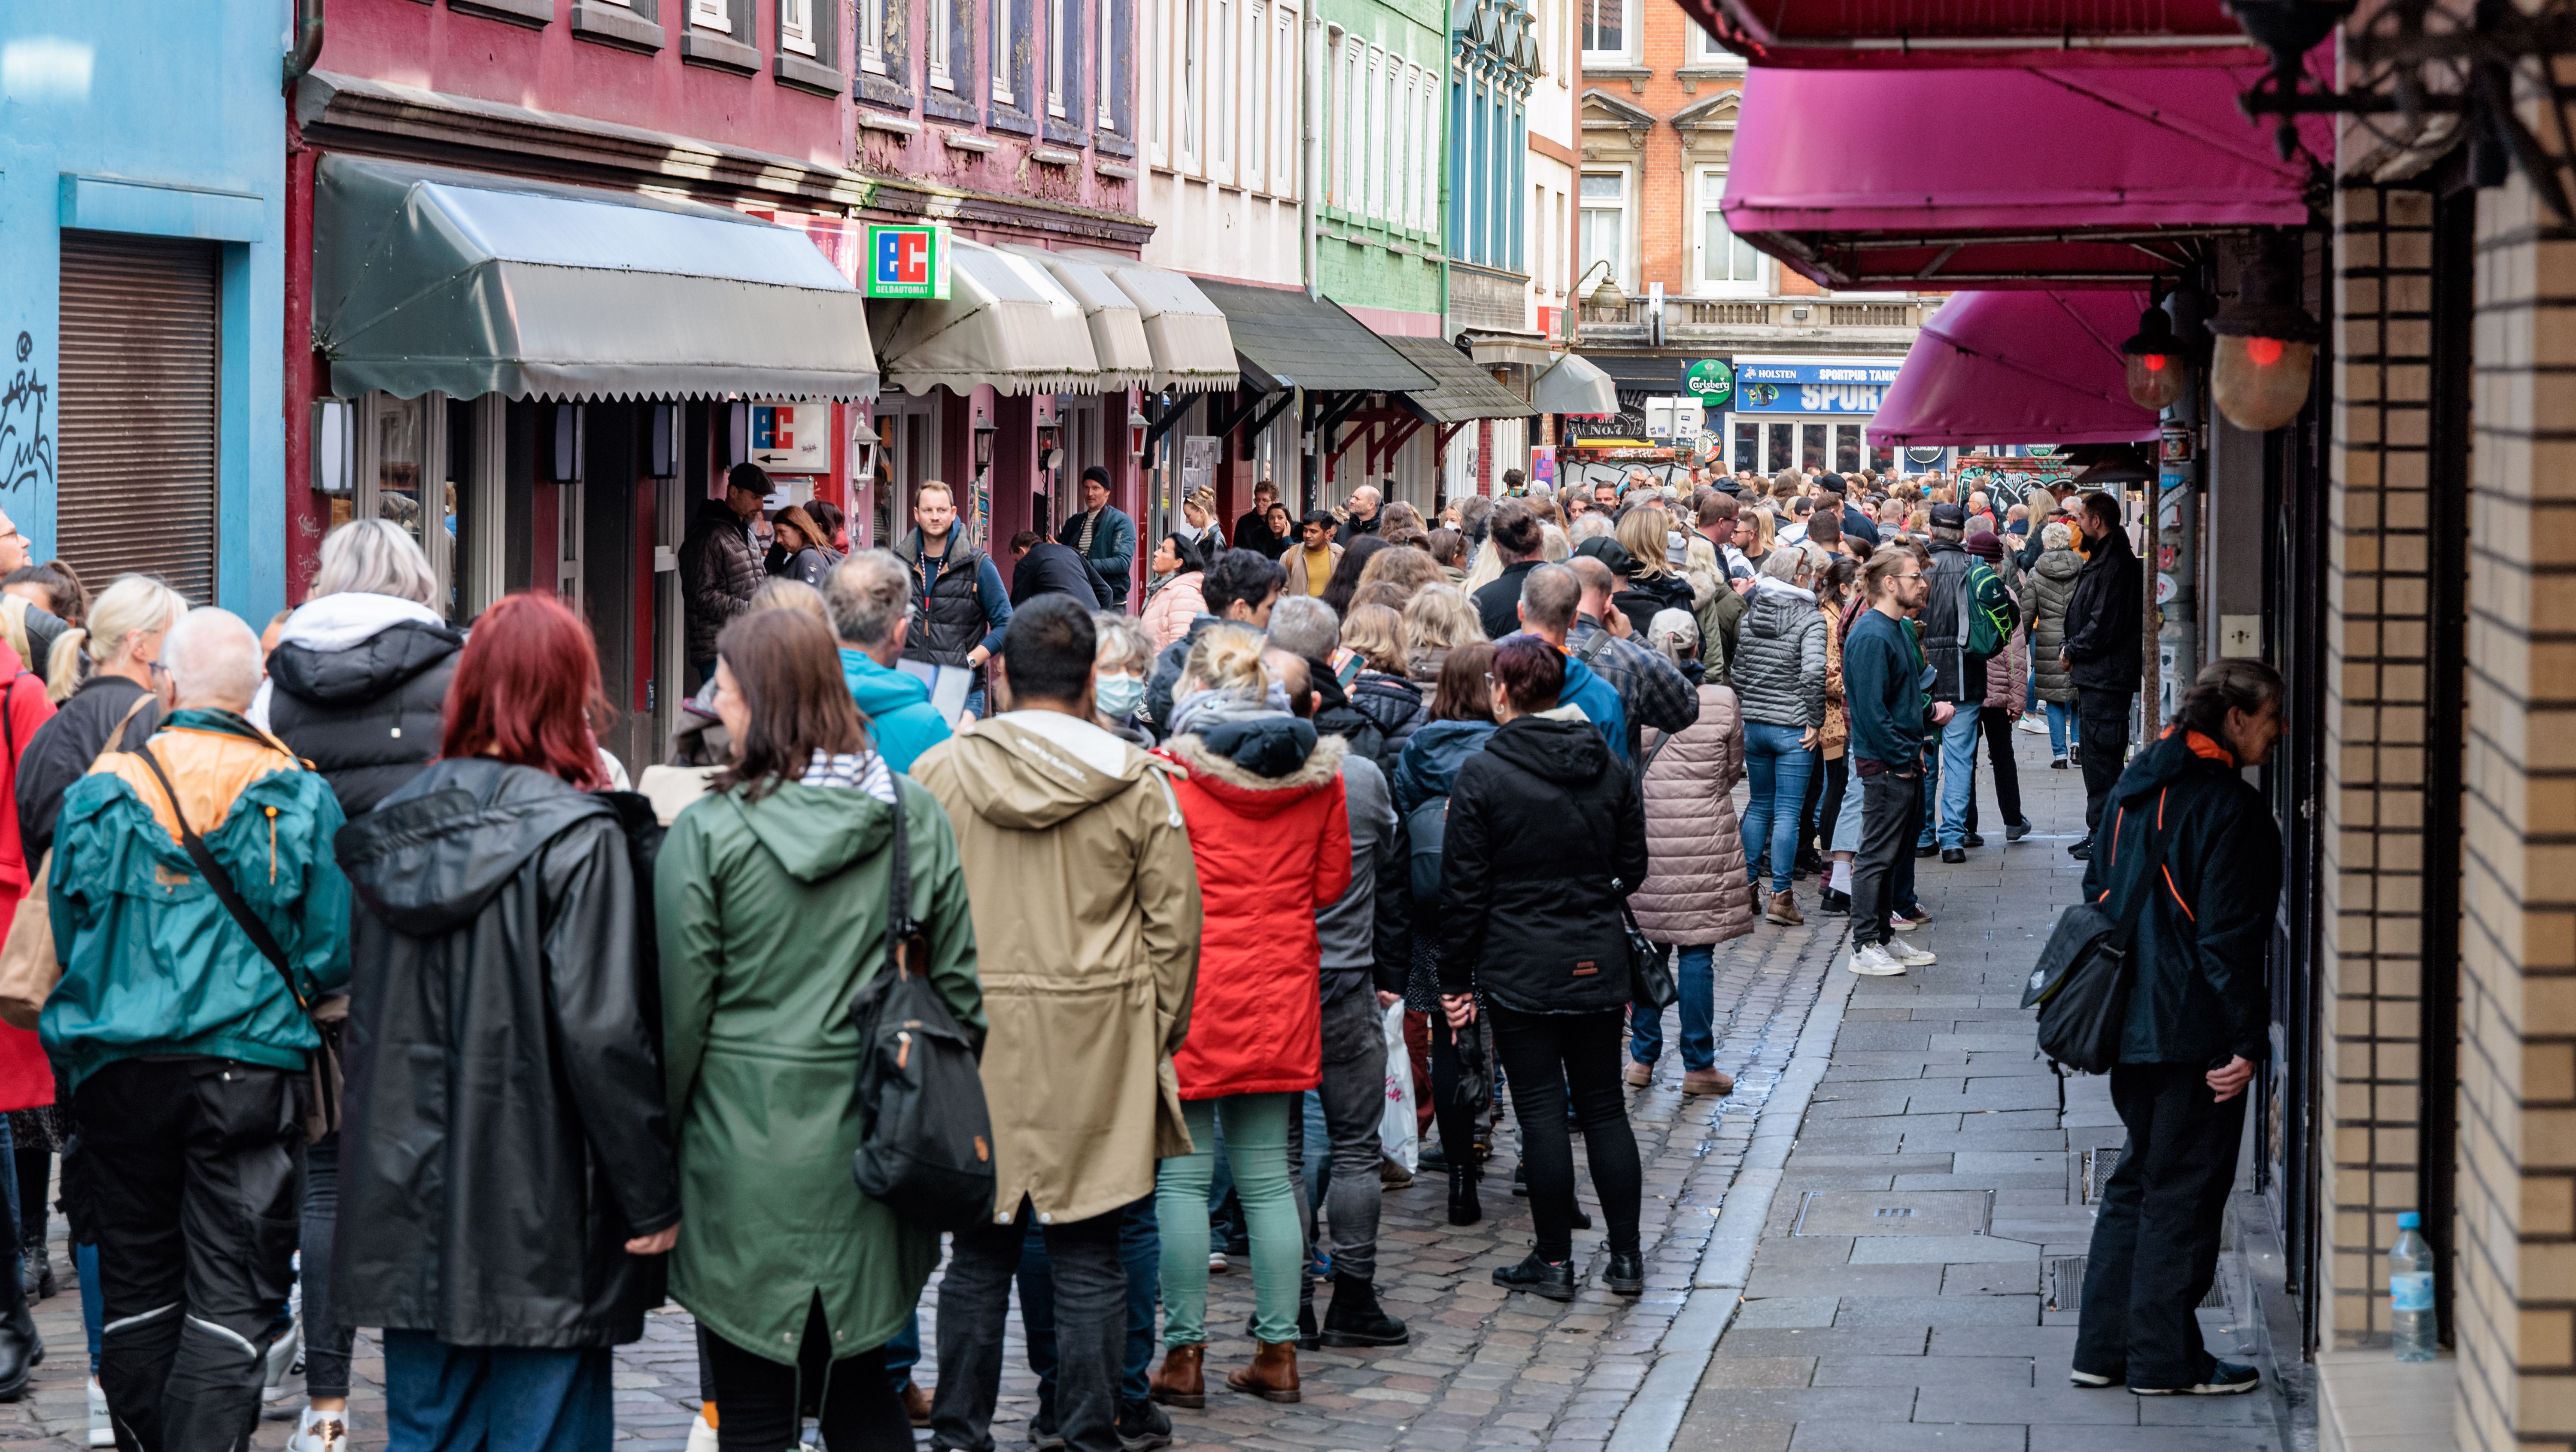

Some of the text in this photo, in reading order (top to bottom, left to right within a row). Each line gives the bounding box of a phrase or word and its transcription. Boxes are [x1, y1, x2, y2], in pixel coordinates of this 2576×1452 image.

[876, 285, 928, 294] GELDAUTOMAT
[1759, 370, 1796, 378] HOLSTEN
[1820, 369, 1867, 381] SPORTPUB
[1689, 377, 1730, 392] Carlsberg
